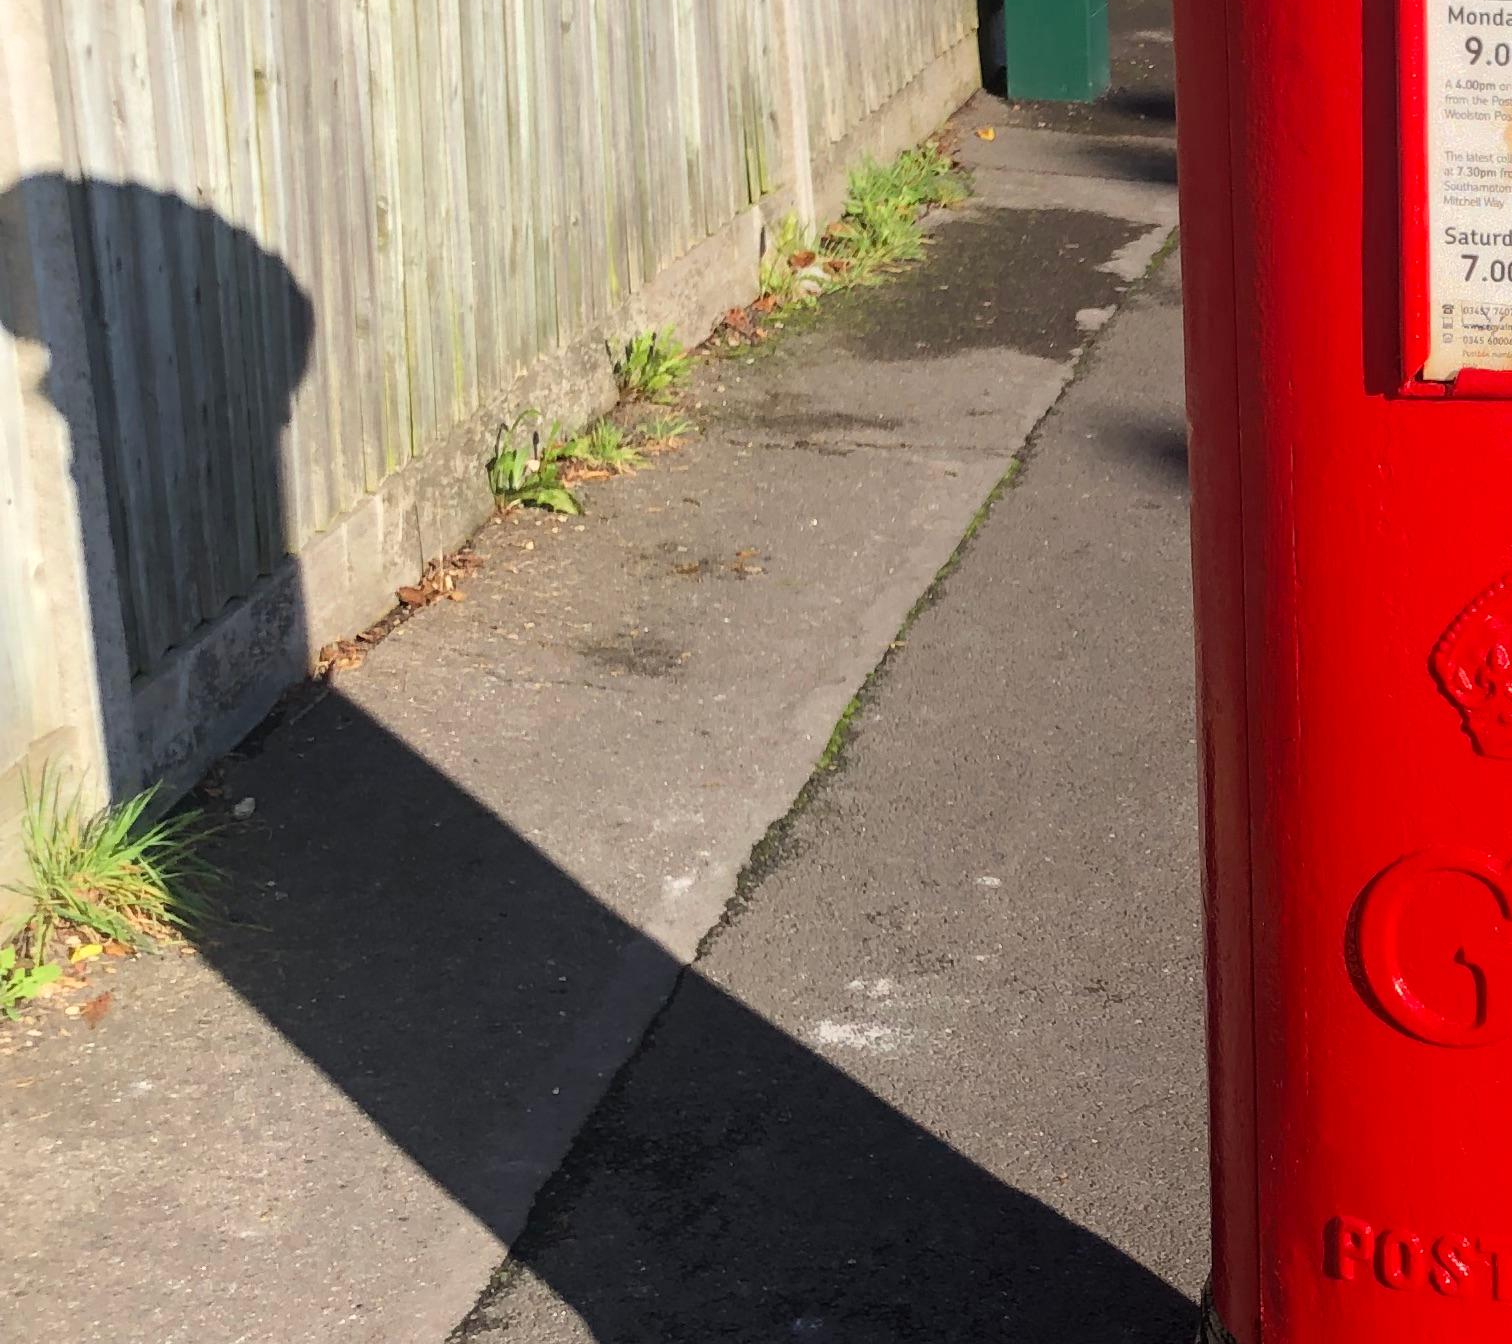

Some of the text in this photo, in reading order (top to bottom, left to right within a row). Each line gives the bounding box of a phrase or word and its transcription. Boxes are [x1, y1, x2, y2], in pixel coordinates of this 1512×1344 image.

[1444, 94, 1469, 105] from
[1471, 95, 1489, 106] the
[1444, 108, 1491, 122] Woolston
[1444, 150, 1464, 163] The
[1465, 152, 1494, 164] latest
[1443, 167, 1453, 177] at
[1456, 165, 1497, 179] 7.30pm
[1443, 180, 1512, 194] Southampton
[1443, 194, 1482, 207] Mitchell
[1462, 336, 1485, 345] 0345
